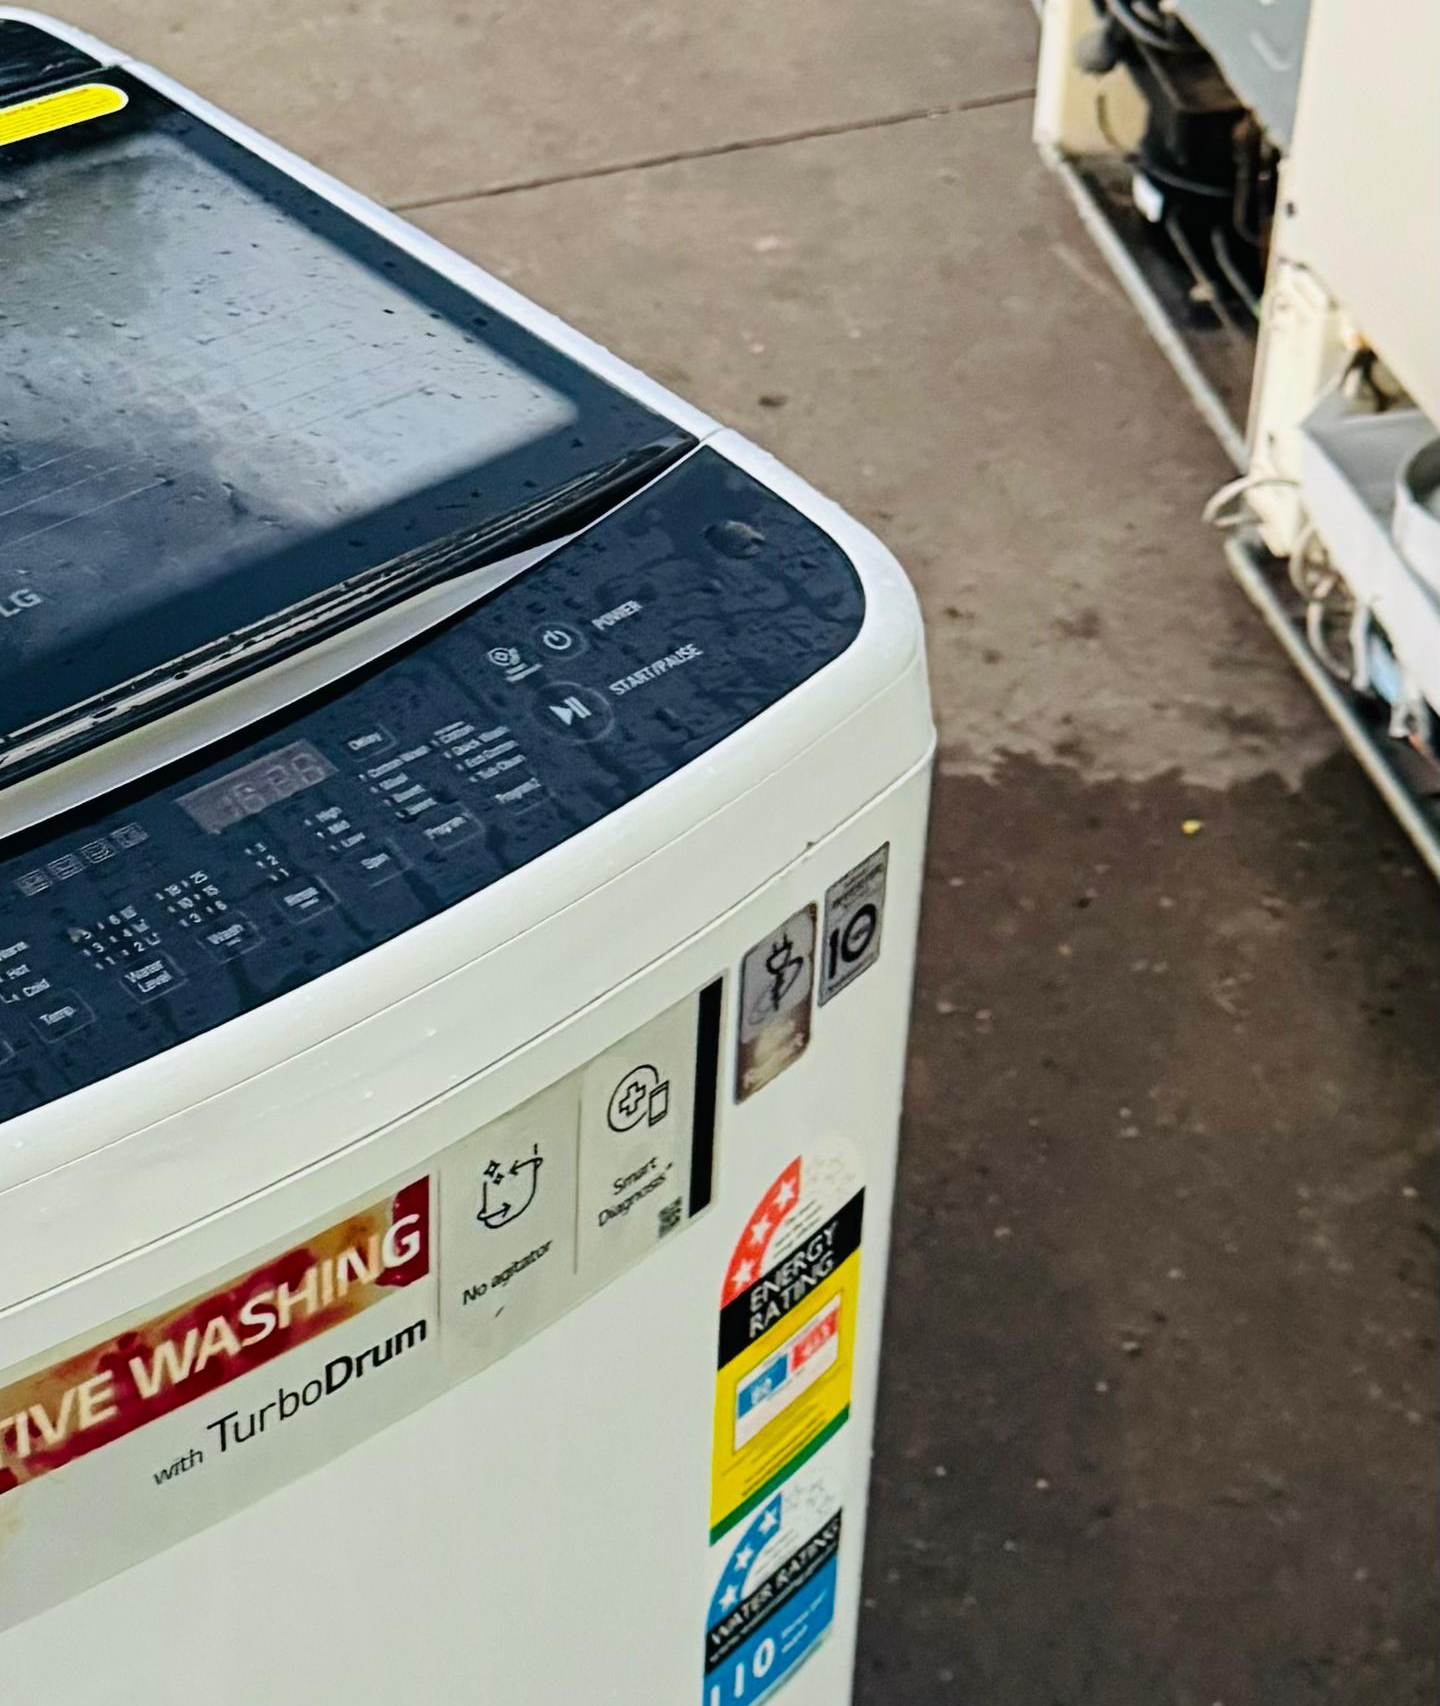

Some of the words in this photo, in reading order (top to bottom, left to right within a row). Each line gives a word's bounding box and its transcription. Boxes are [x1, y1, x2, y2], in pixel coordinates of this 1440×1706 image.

[591, 599, 643, 631] POWER
[609, 643, 705, 696] START/PAUSE
[266, 855, 280, 866] 2
[124, 960, 164, 984] Water
[138, 971, 173, 994] Level
[612, 1156, 658, 1196] Smart
[462, 1281, 489, 1306] No
[490, 1239, 554, 1290] agitator
[749, 1220, 840, 1313] ENERGY
[128, 1212, 423, 1400] WASHING
[748, 1249, 836, 1339] RATING
[152, 1447, 205, 1487] with
[206, 1318, 429, 1455] TurboDrum
